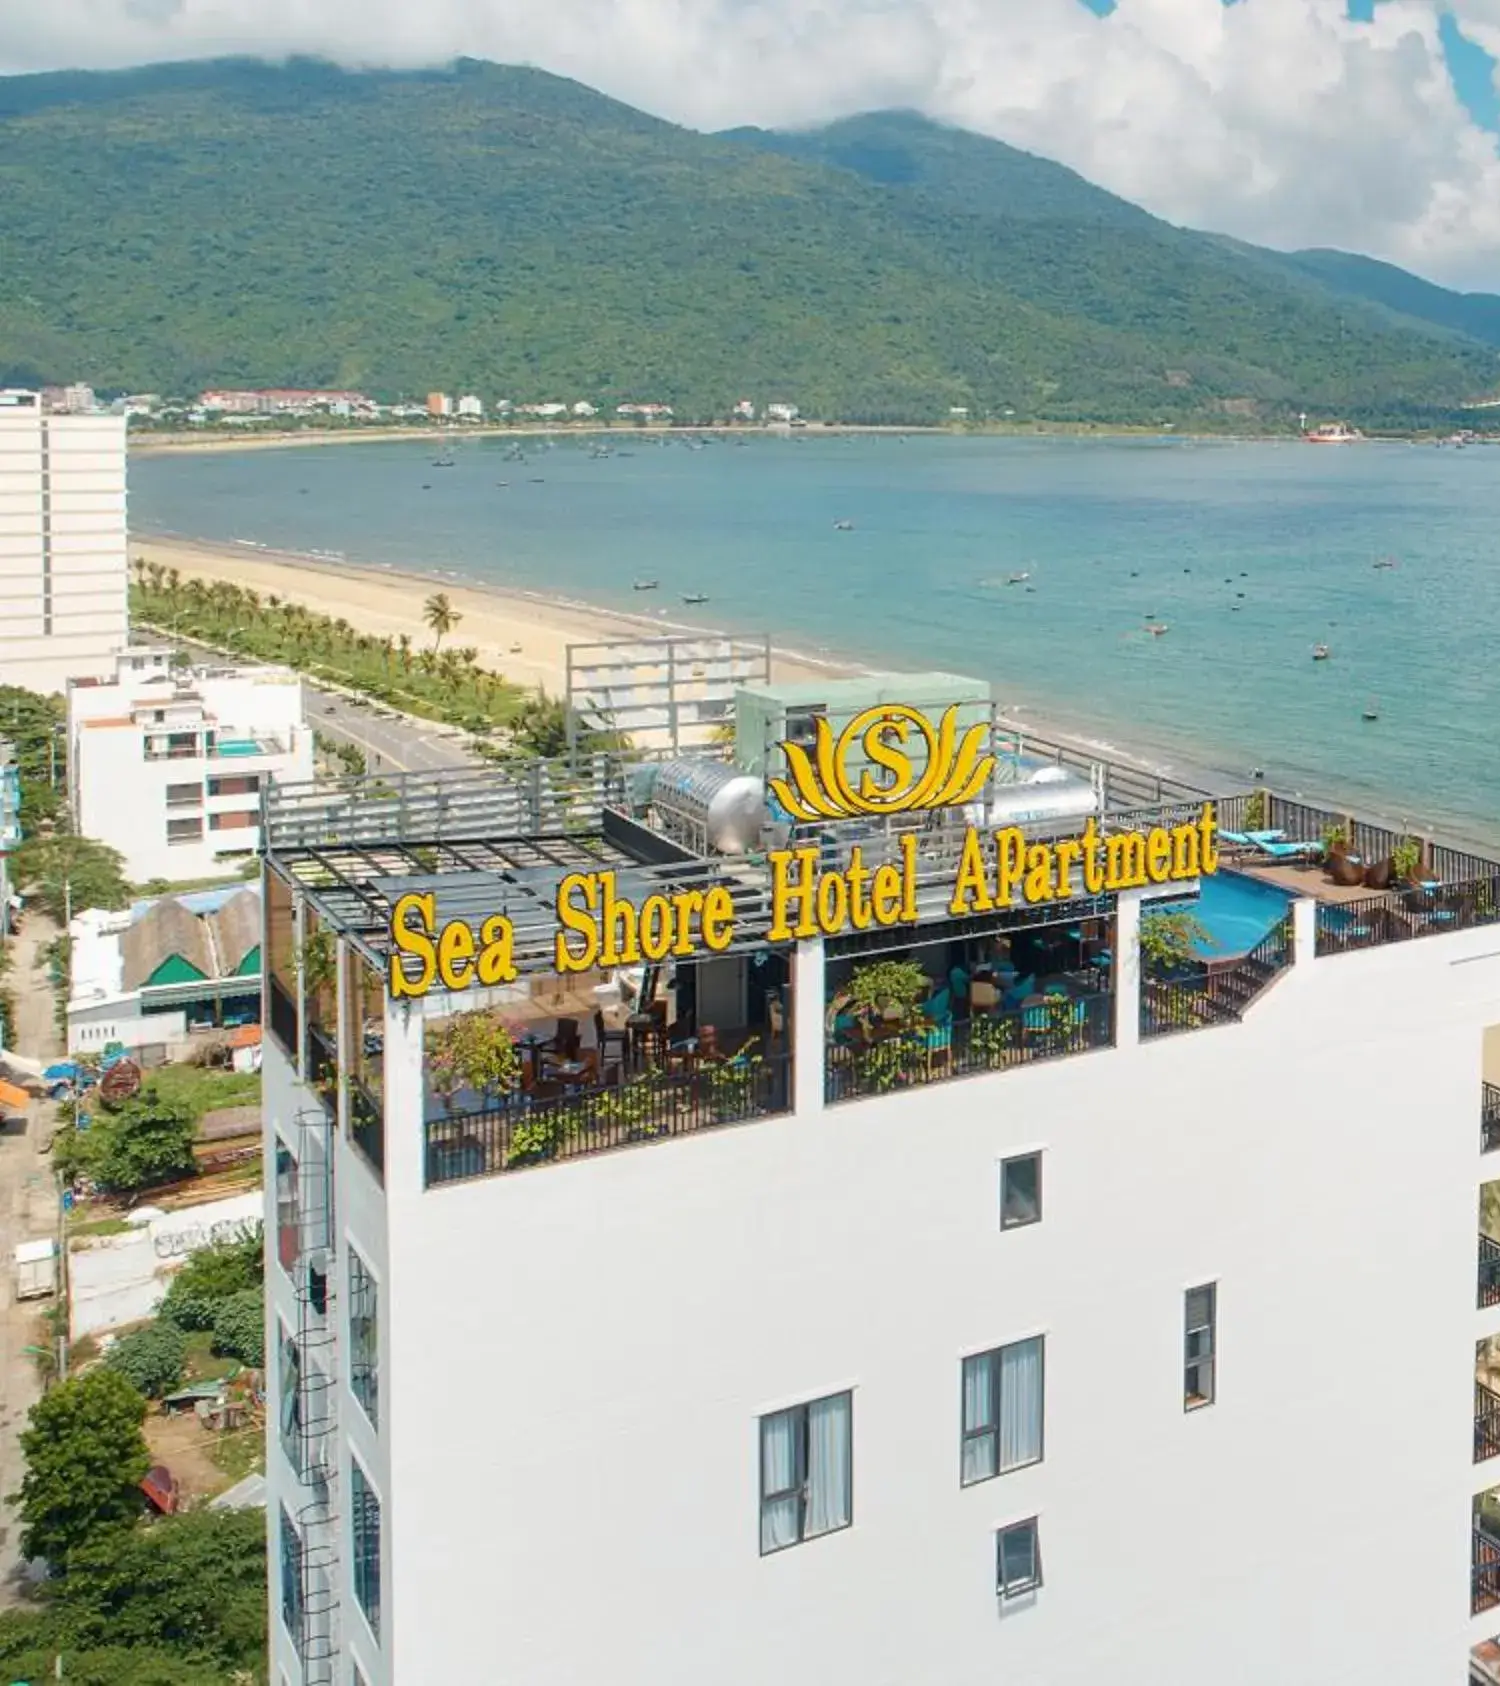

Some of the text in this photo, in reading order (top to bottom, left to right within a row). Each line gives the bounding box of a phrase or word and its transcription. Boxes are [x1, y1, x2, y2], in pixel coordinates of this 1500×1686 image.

[860, 718, 913, 799] S
[390, 892, 518, 998] Sea
[555, 869, 735, 973] Shore
[766, 832, 919, 942] Hotel
